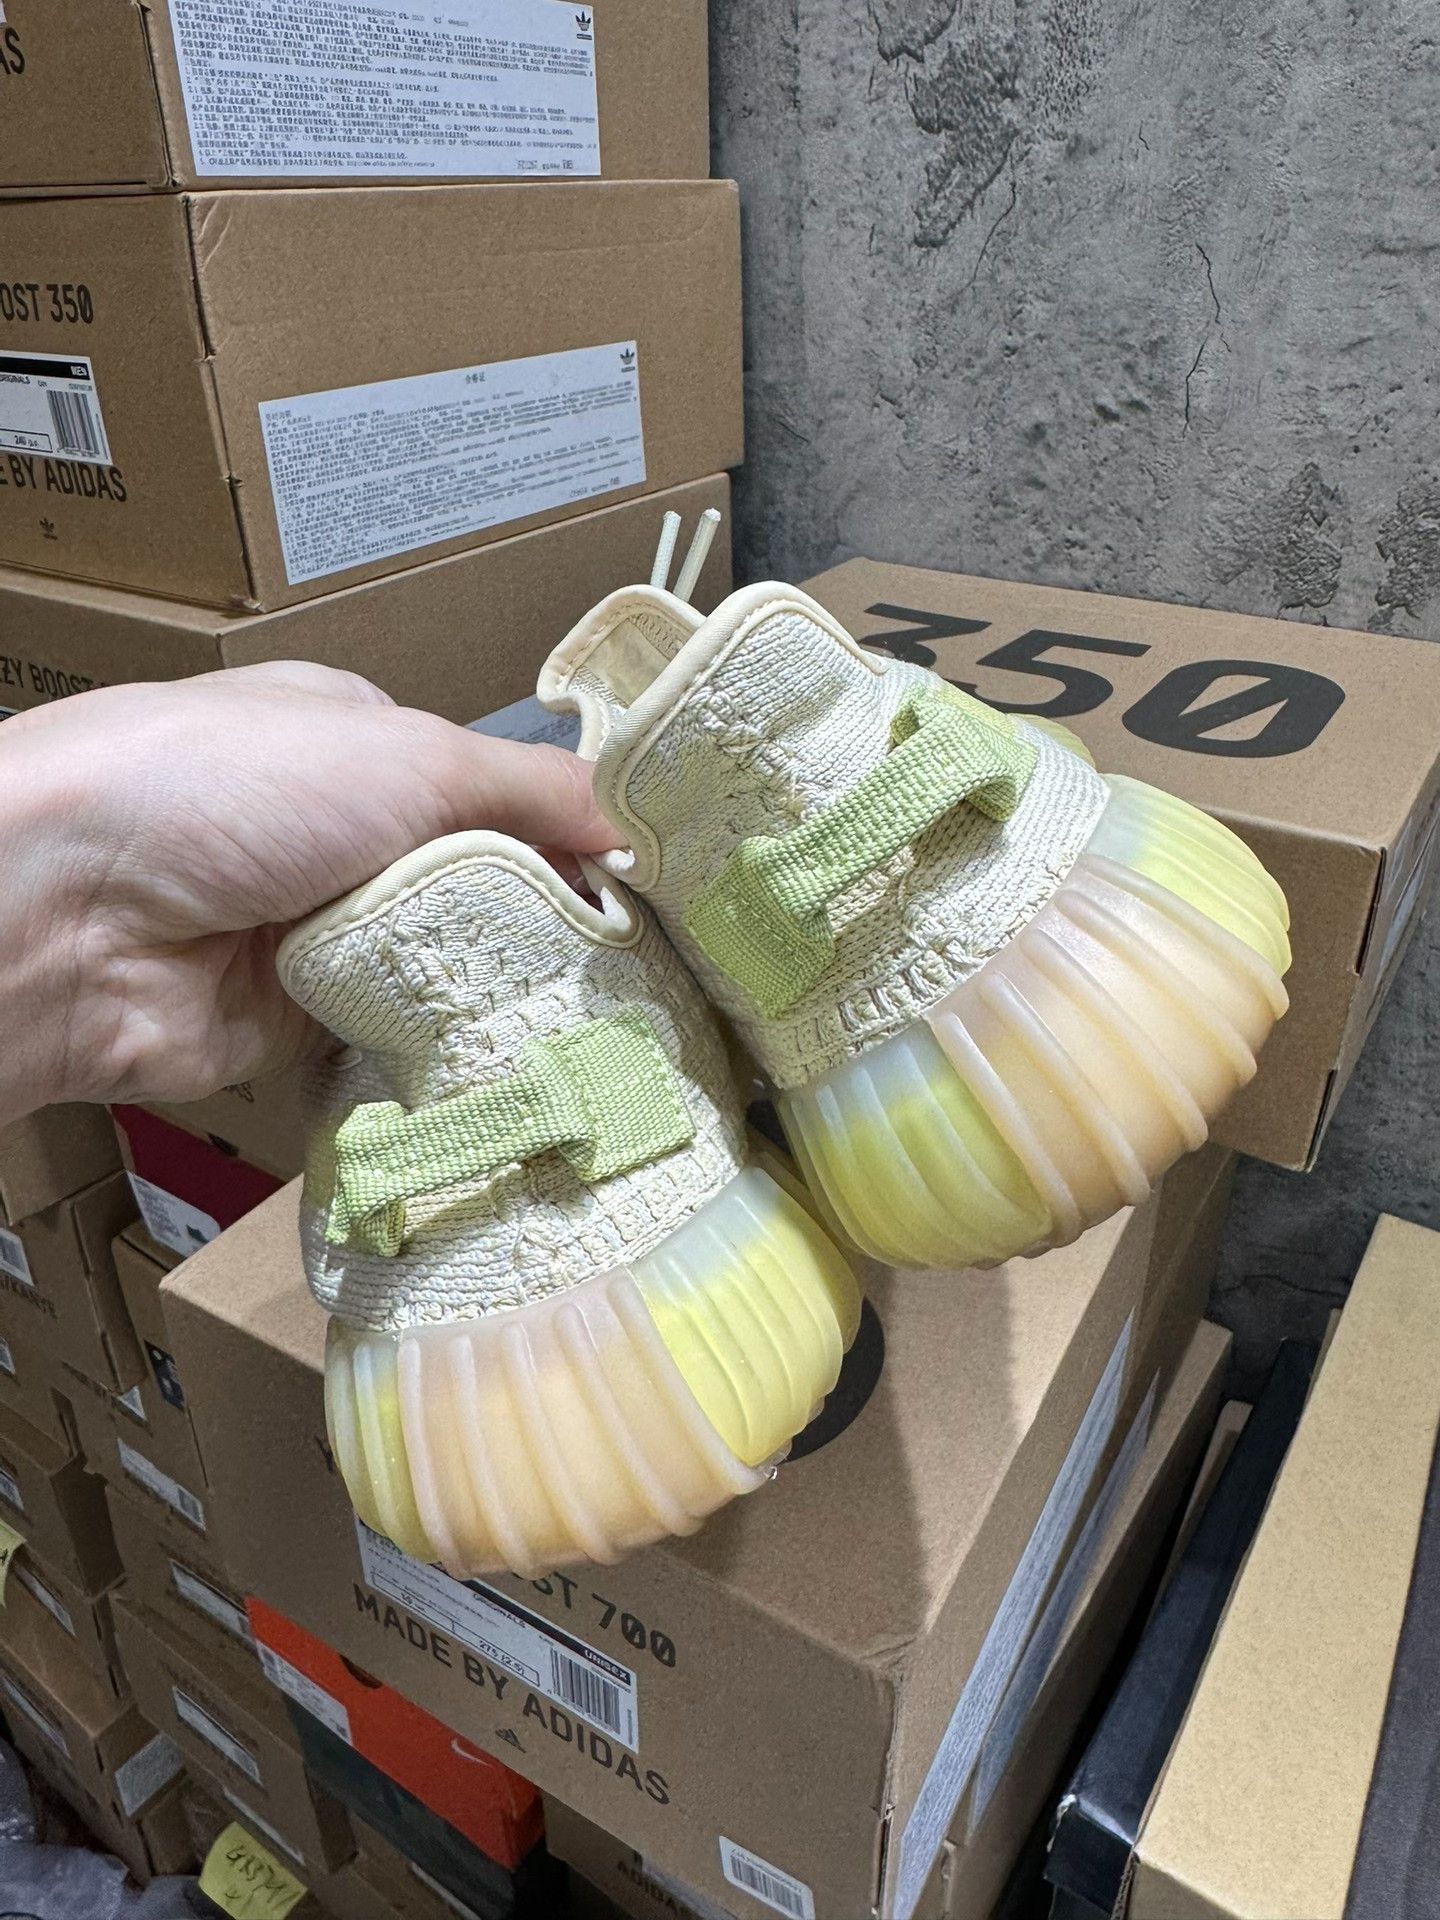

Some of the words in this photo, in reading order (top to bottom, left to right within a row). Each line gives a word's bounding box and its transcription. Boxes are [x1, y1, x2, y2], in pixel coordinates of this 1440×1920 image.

[46, 284, 94, 324] 350
[8, 454, 37, 489] BY
[45, 459, 128, 502] ADIDAS
[861, 603, 1346, 758] 350
[591, 1592, 676, 1667] 700
[352, 1583, 453, 1669] MADE
[463, 1650, 510, 1701] BY
[522, 1692, 671, 1805] ADIDAS
